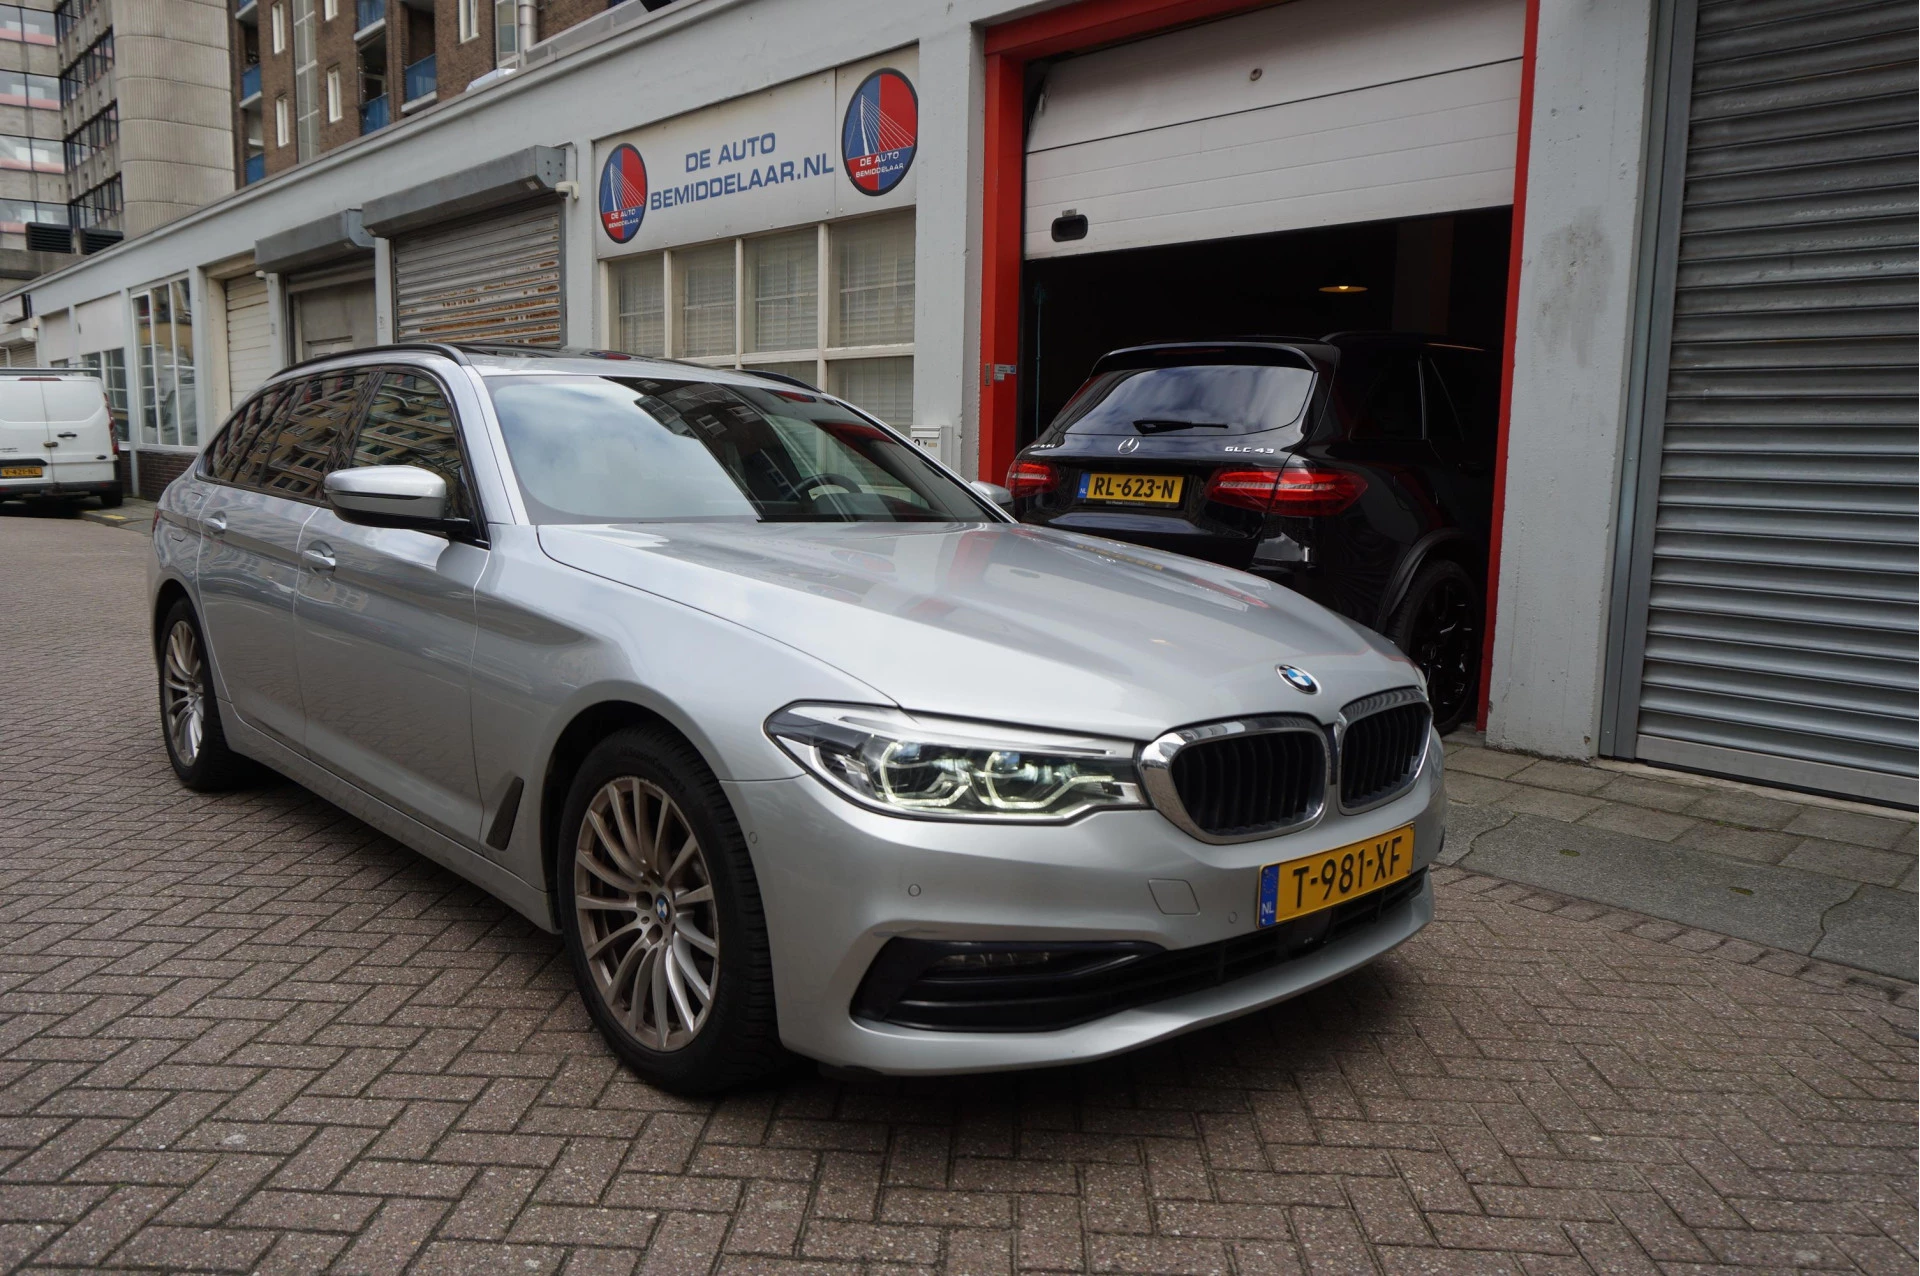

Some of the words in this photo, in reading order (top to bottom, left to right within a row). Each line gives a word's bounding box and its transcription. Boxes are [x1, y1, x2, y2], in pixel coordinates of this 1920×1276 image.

[685, 149, 711, 173] DE
[717, 132, 776, 165] AUTO
[860, 157, 872, 167] DE
[874, 151, 900, 163] AUTO
[650, 153, 834, 211] BEMIDDELAAR.NL
[855, 163, 904, 178] BEMIDDELAAR
[610, 212, 619, 220] DE
[620, 208, 636, 218] AUTO
[1093, 476, 1175, 499] RL-623-N
[1261, 901, 1275, 916] NL
[1292, 835, 1402, 909] T-981-XF
